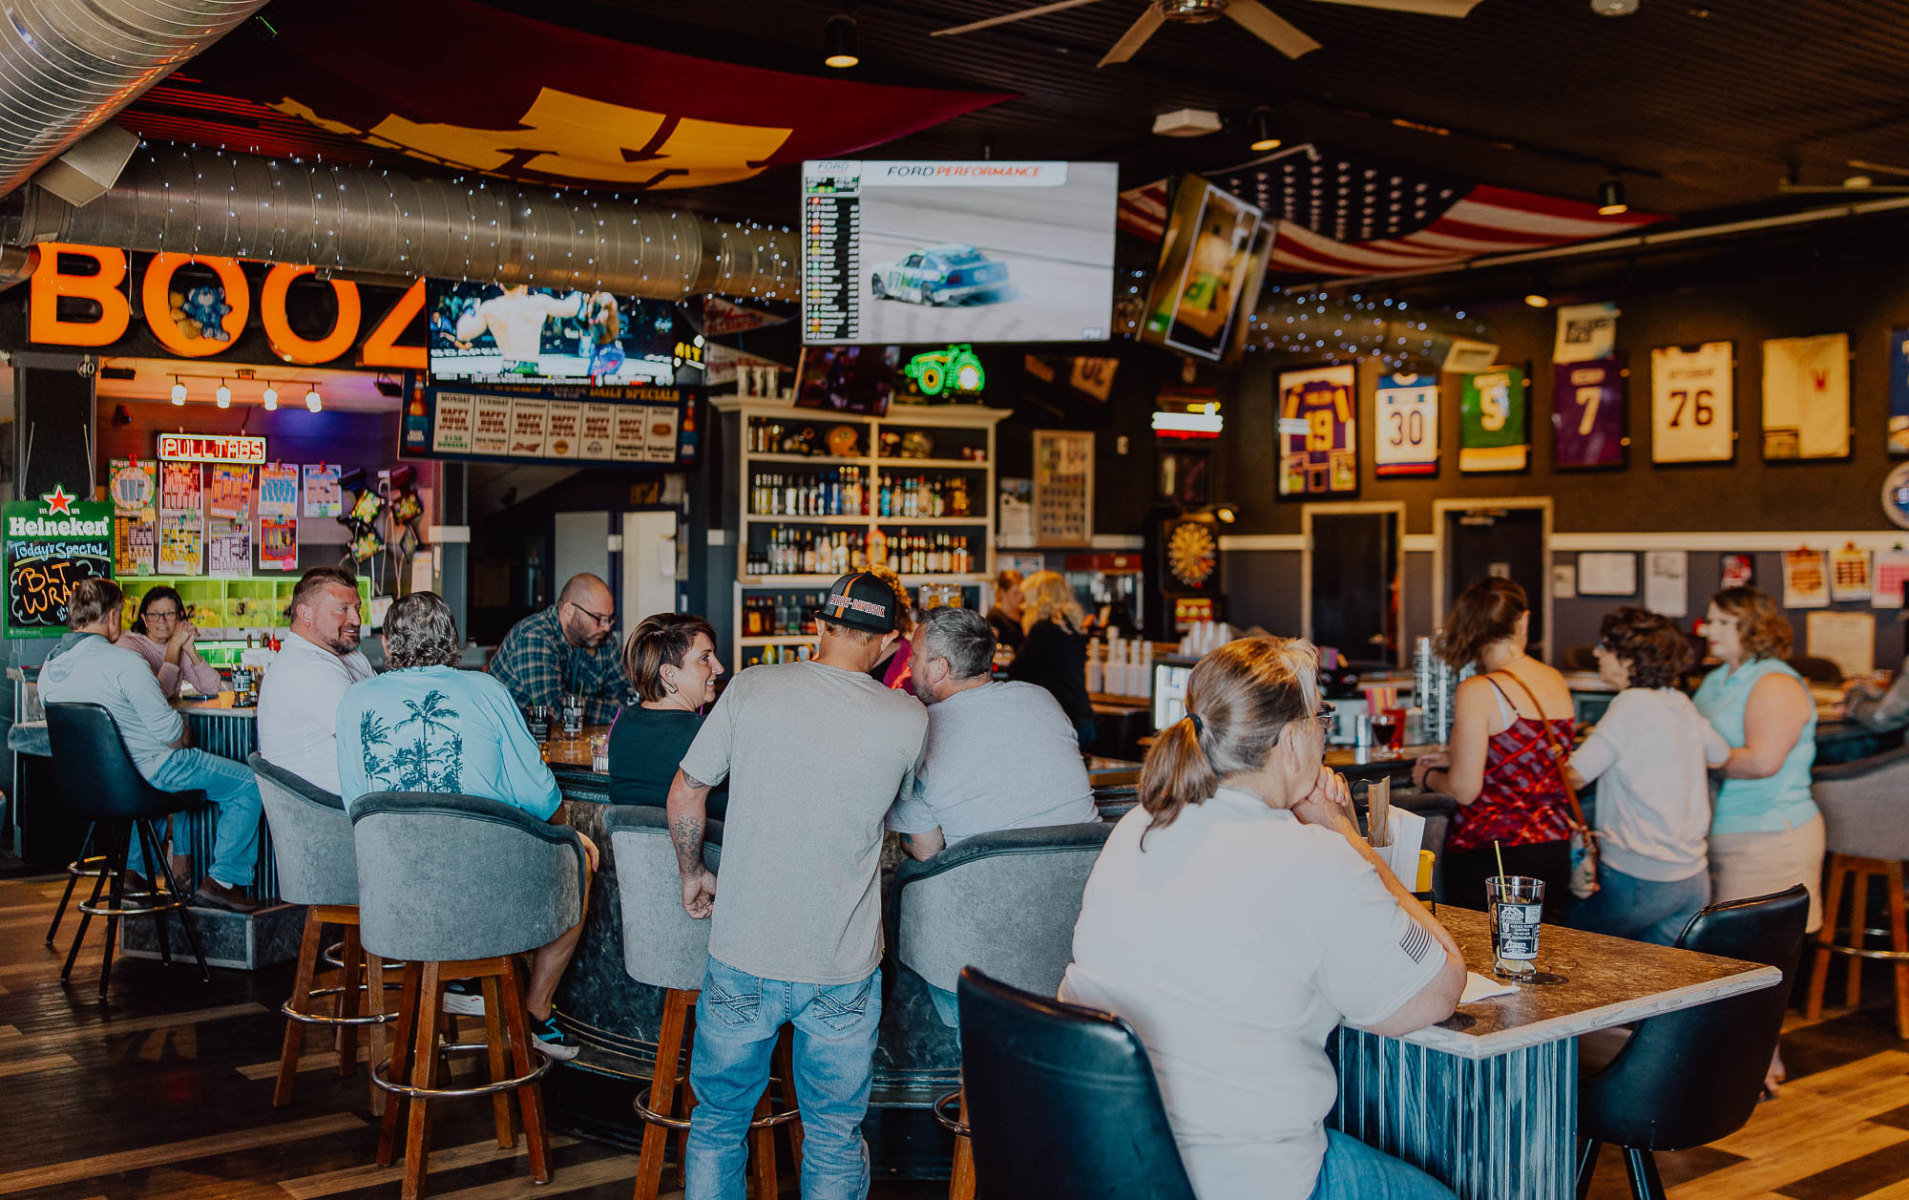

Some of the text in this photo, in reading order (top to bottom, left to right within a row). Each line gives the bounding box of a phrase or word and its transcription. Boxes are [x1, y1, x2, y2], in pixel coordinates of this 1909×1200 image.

[887, 166, 1041, 178] FORD PERFORMANCE
[441, 395, 470, 404] MONDAY
[625, 388, 680, 402] SPECIALS
[479, 398, 509, 406] TUESDAY
[441, 408, 468, 417] HAPPY
[1575, 387, 1603, 435] 7
[1669, 389, 1714, 427] 76
[479, 410, 506, 419] HAPPY
[516, 412, 543, 420] HAPPY
[551, 415, 576, 423] HAPPY
[442, 416, 466, 425] HOUR
[480, 419, 504, 427] HOUR
[517, 421, 540, 429] HOUR
[585, 417, 610, 425] HAPPY
[552, 423, 574, 431] HOUR
[587, 425, 608, 433] HOUR
[1304, 409, 1334, 452] 19
[1389, 410, 1423, 446] 30
[9, 516, 109, 536] Heineken
[55, 542, 108, 559] Special
[18, 562, 71, 593] BLT
[236, 602, 246, 616] 3
